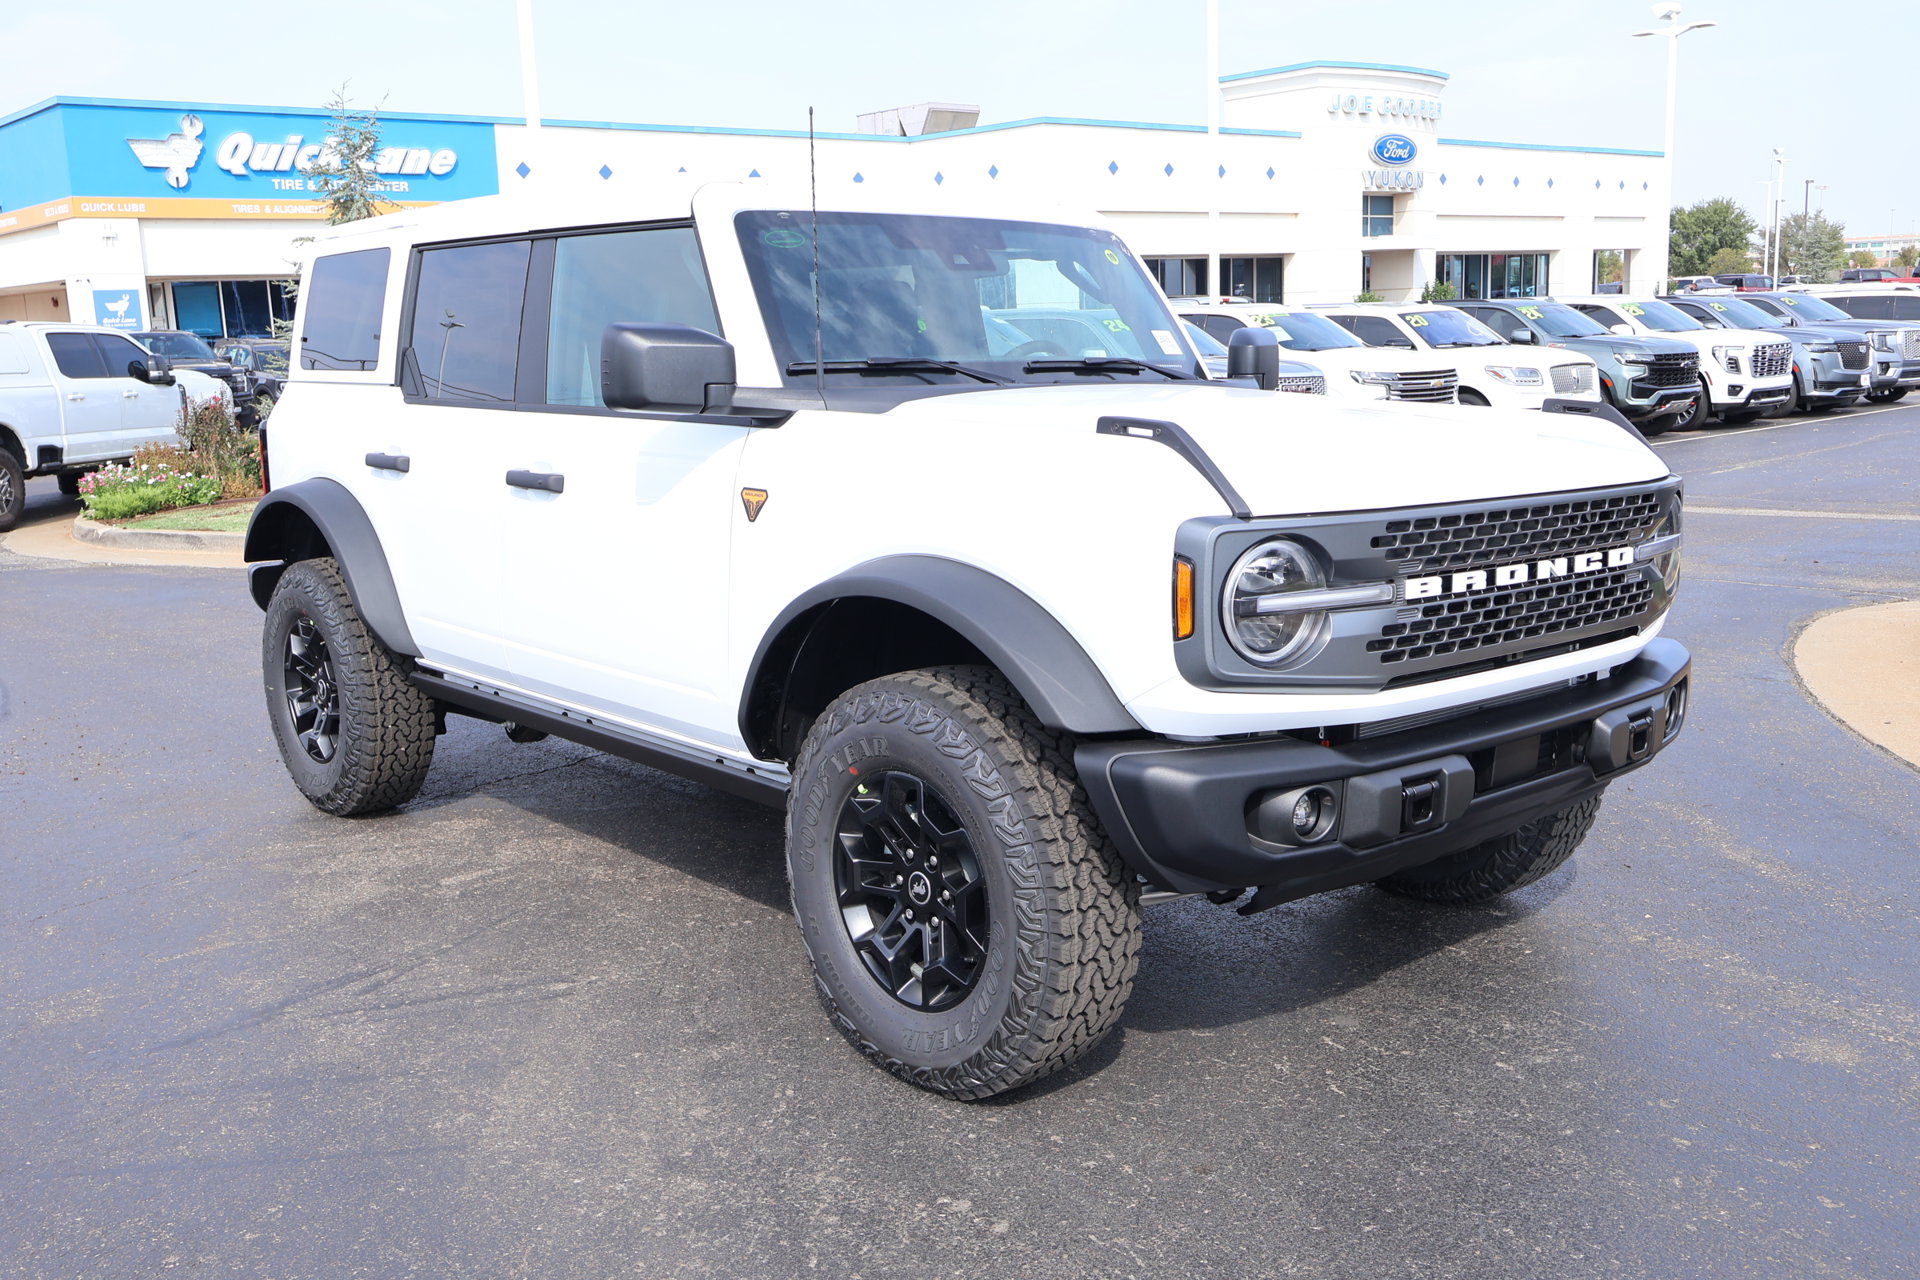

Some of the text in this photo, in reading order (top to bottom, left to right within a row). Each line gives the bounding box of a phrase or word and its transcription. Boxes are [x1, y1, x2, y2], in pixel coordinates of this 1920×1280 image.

[1329, 94, 1442, 120] JOE COOPER
[1383, 139, 1411, 159] Ford
[272, 178, 304, 191] TIRE
[307, 178, 317, 191] &
[1365, 170, 1424, 189] YUKON
[80, 202, 115, 213] QUICK
[117, 202, 146, 213] LUBE
[231, 204, 261, 214] TIRES
[1102, 318, 1132, 332] 24
[1405, 314, 1429, 328] 20
[1404, 546, 1635, 601] BRONCO
